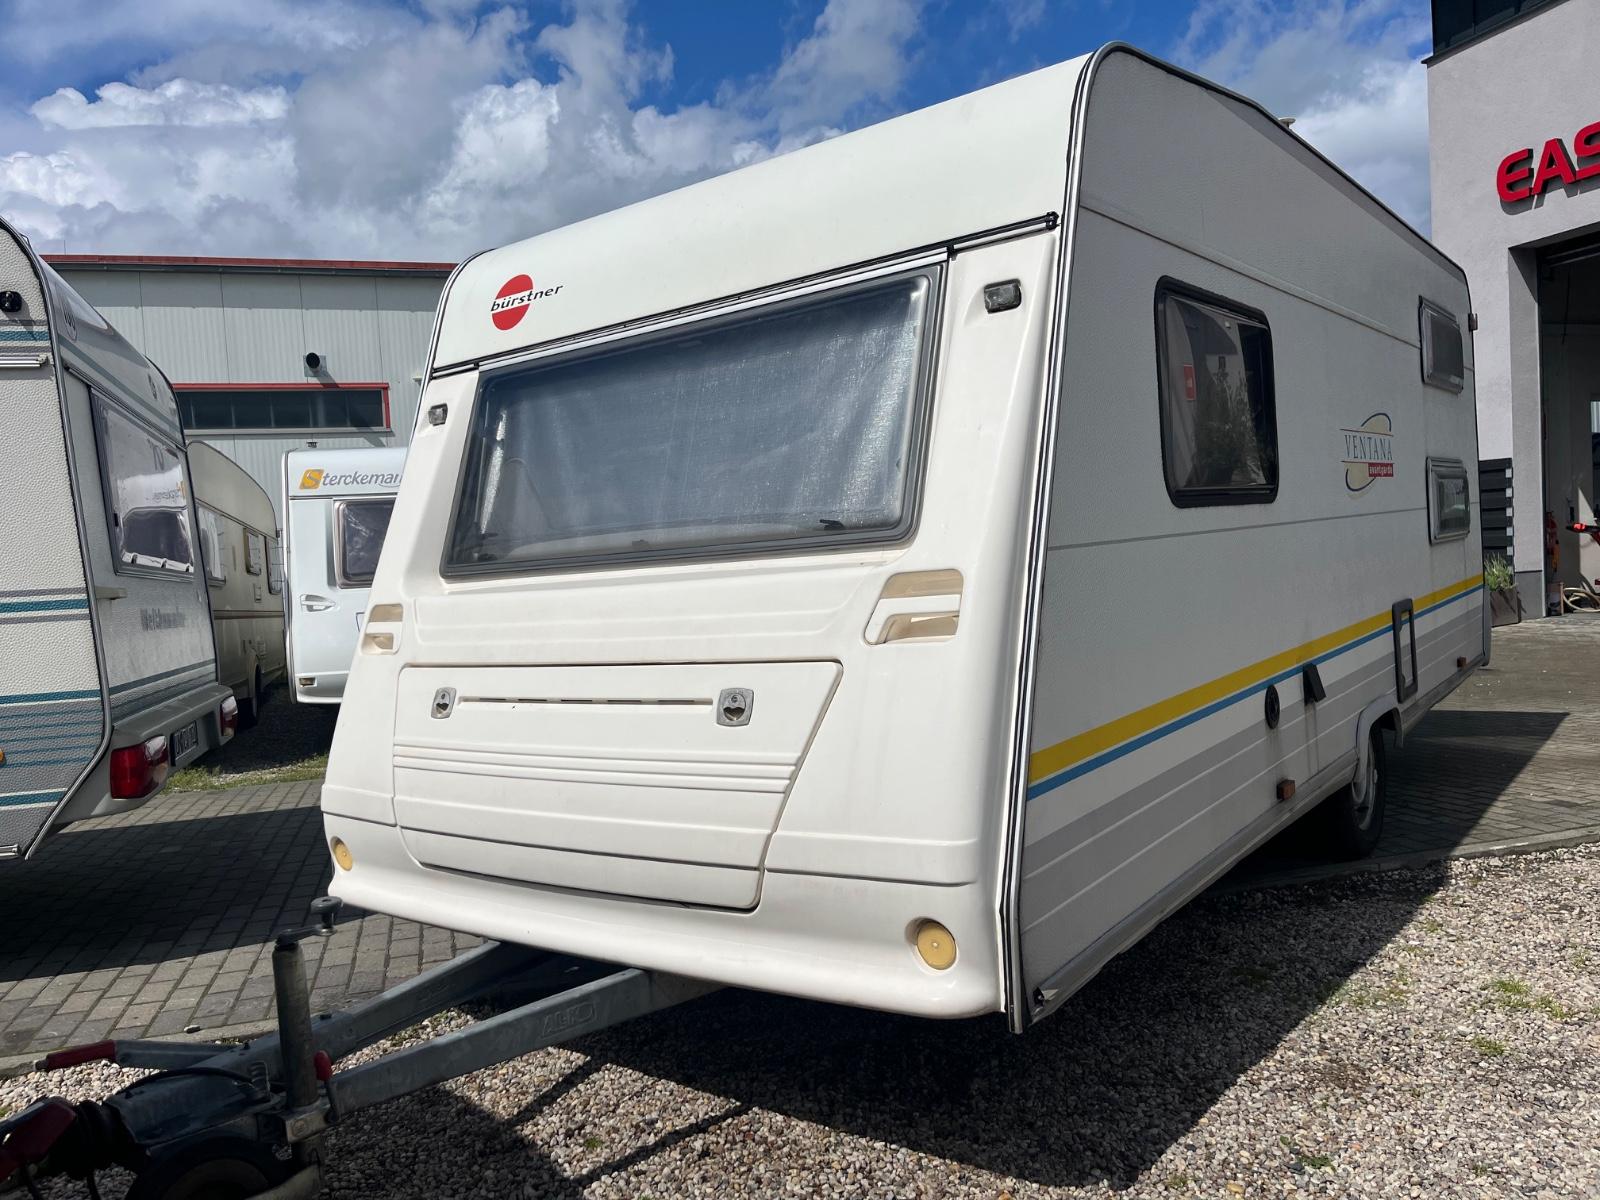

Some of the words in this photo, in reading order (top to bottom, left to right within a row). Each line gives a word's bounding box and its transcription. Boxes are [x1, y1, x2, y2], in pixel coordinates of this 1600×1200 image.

[1496, 120, 1600, 203] EAS
[490, 284, 564, 312] bürstner
[1344, 434, 1393, 461] VENTANA
